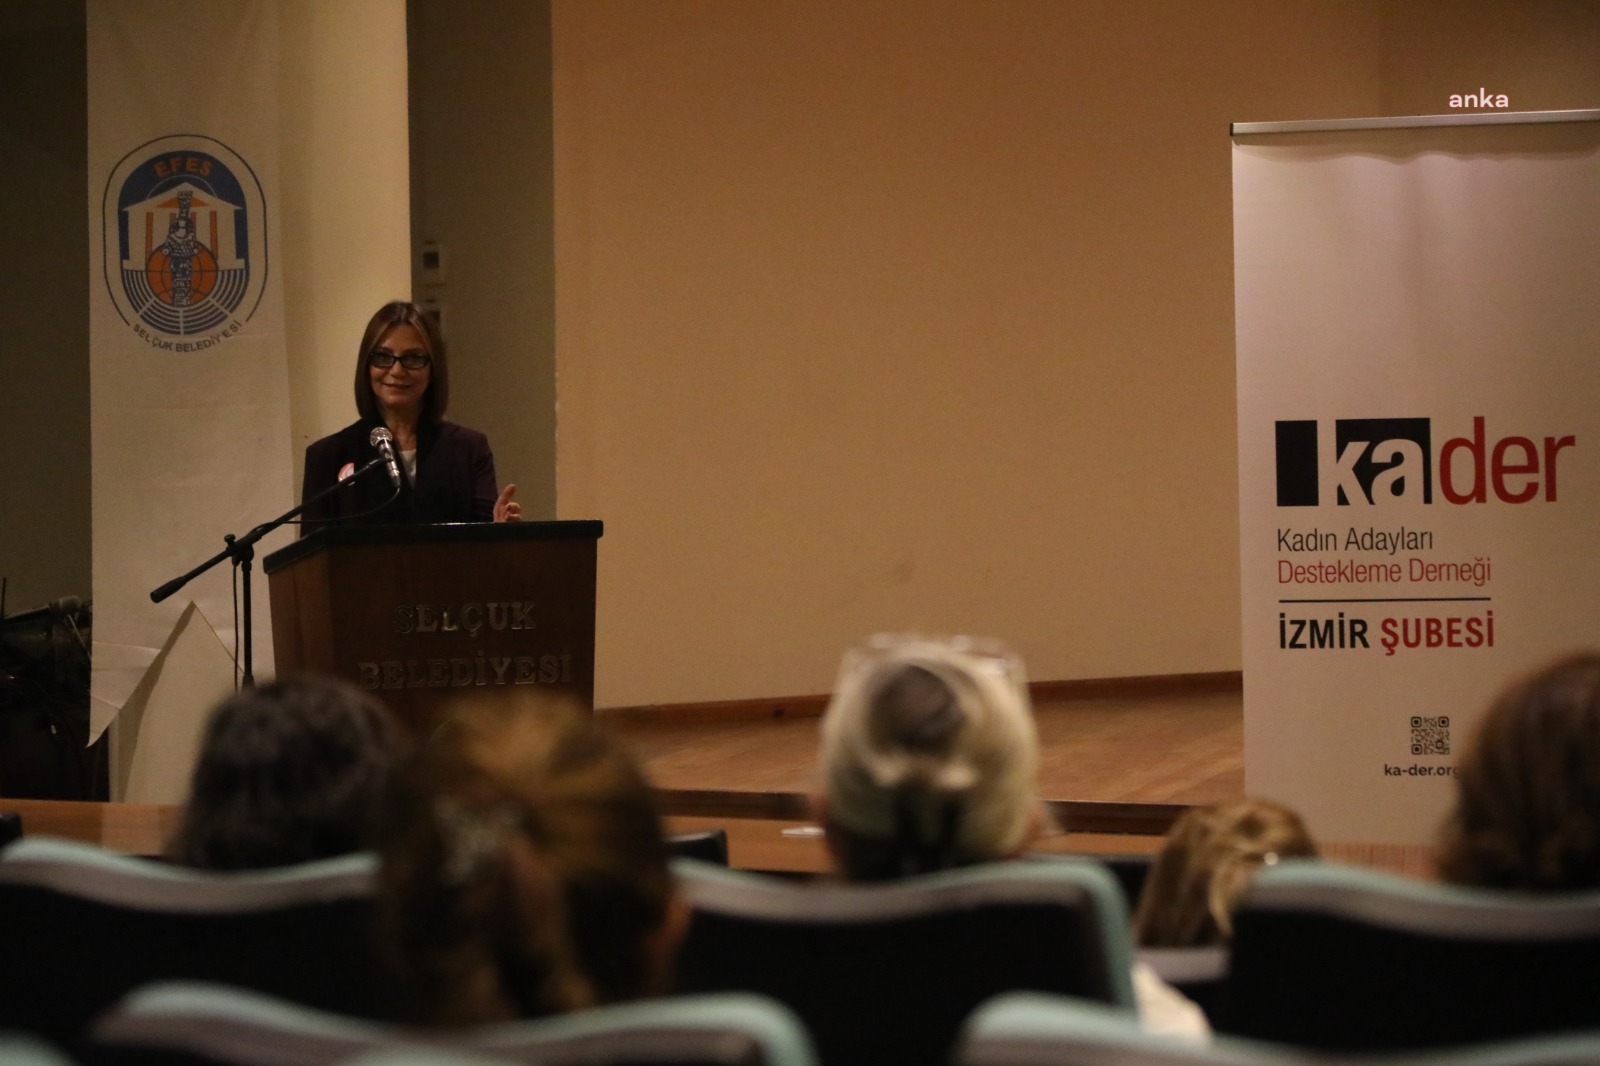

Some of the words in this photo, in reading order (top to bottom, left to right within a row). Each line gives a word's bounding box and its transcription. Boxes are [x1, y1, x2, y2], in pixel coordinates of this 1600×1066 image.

[154, 157, 213, 177] EFES
[133, 323, 173, 351] SELÇUK
[1277, 528, 1337, 552] Kadın
[1344, 526, 1433, 555] Adayları
[1278, 559, 1402, 583] Destekleme
[1409, 557, 1491, 587] Derneği
[394, 602, 537, 637] SELÇUK
[1279, 612, 1370, 649] İZMİR
[1381, 610, 1494, 656] ŞUBESİ
